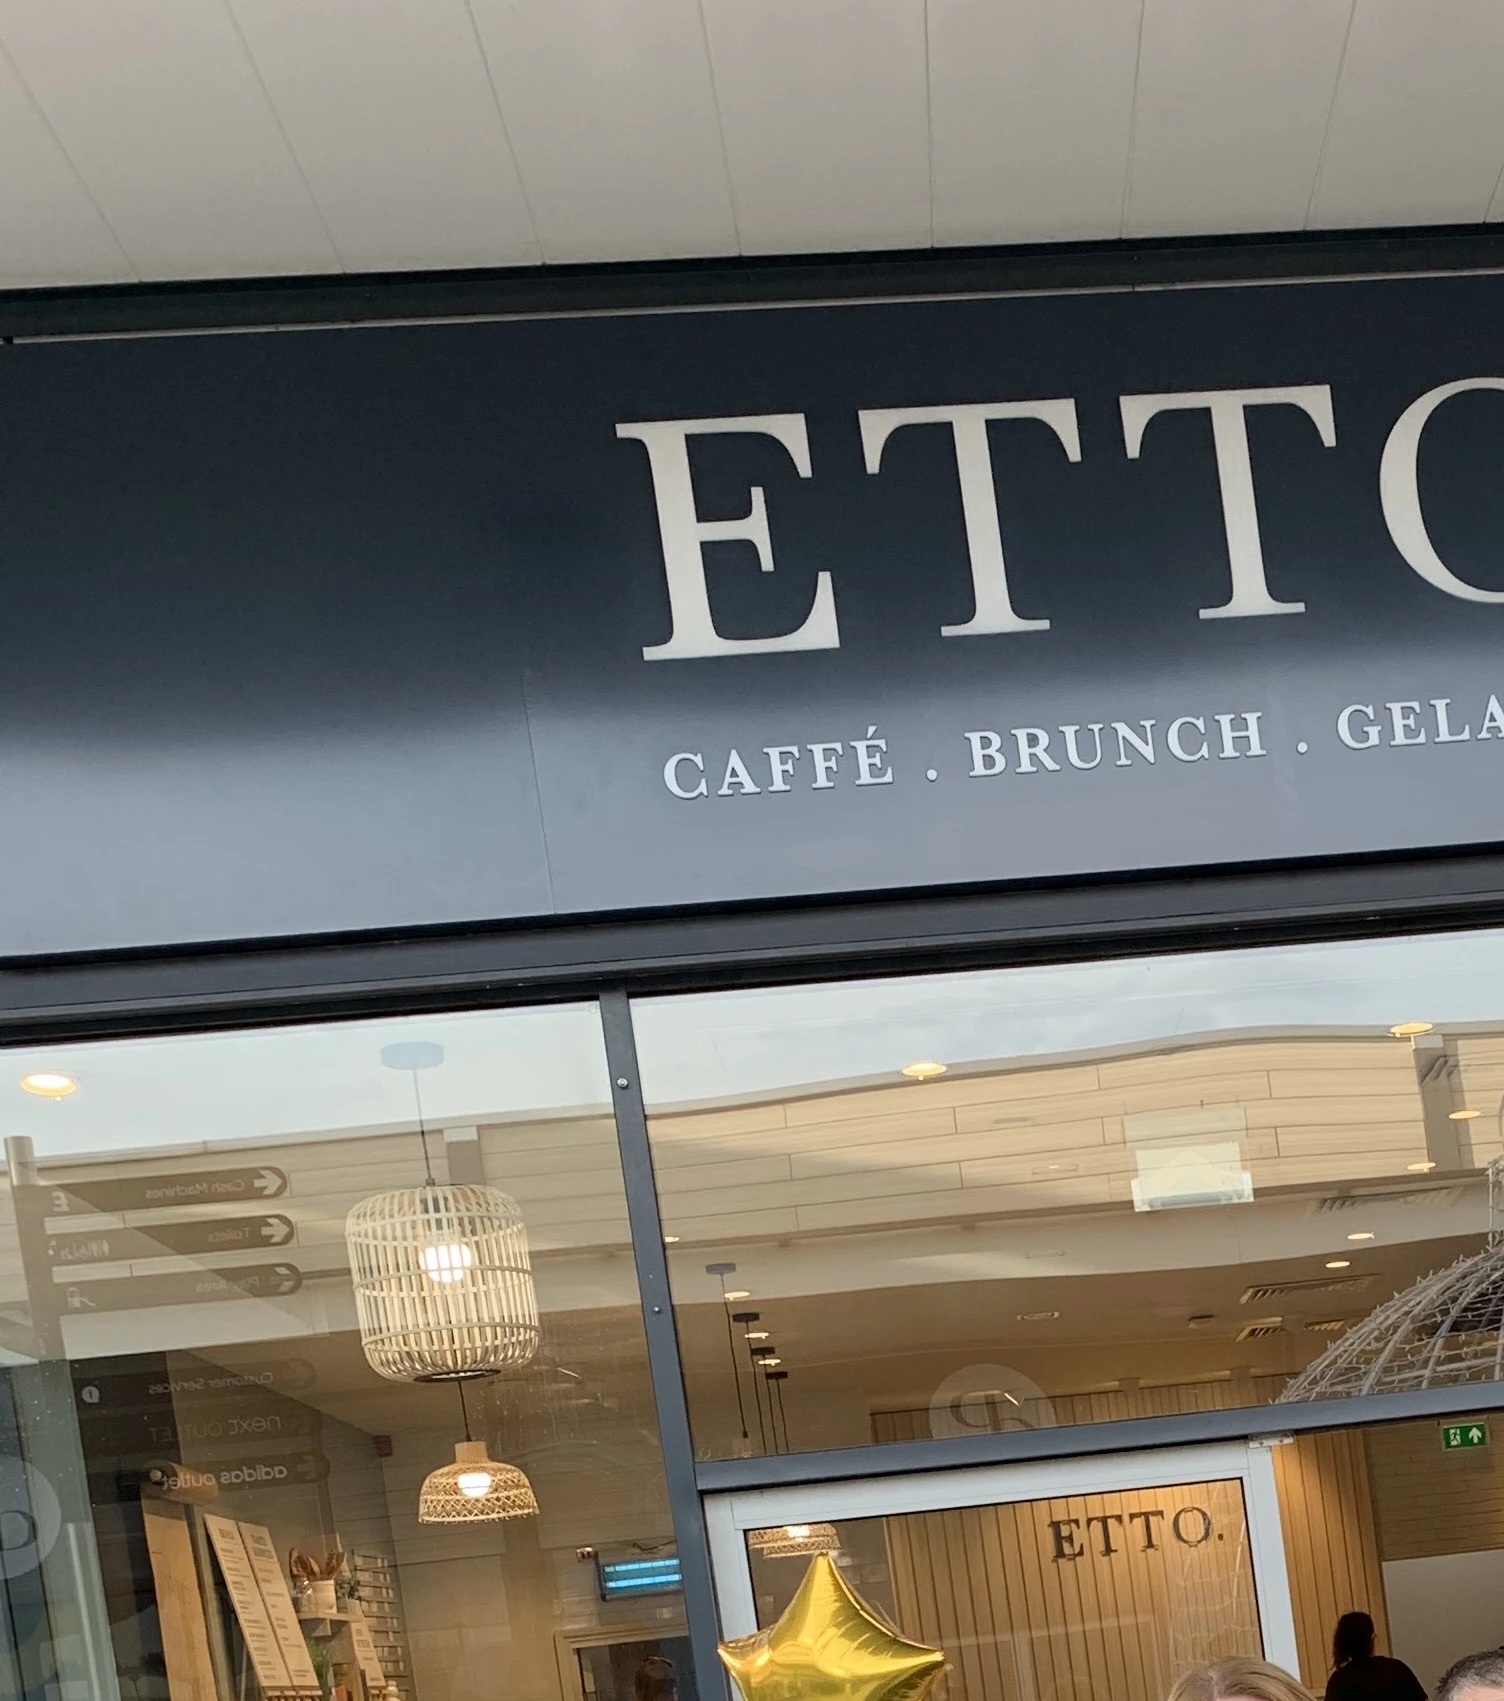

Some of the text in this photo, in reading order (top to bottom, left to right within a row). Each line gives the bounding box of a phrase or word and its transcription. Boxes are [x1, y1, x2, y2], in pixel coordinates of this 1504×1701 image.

[662, 725, 895, 801] CAFFÉ
[963, 711, 1267, 779] BRUNCH
[1048, 1506, 1224, 1562] ETTO.
